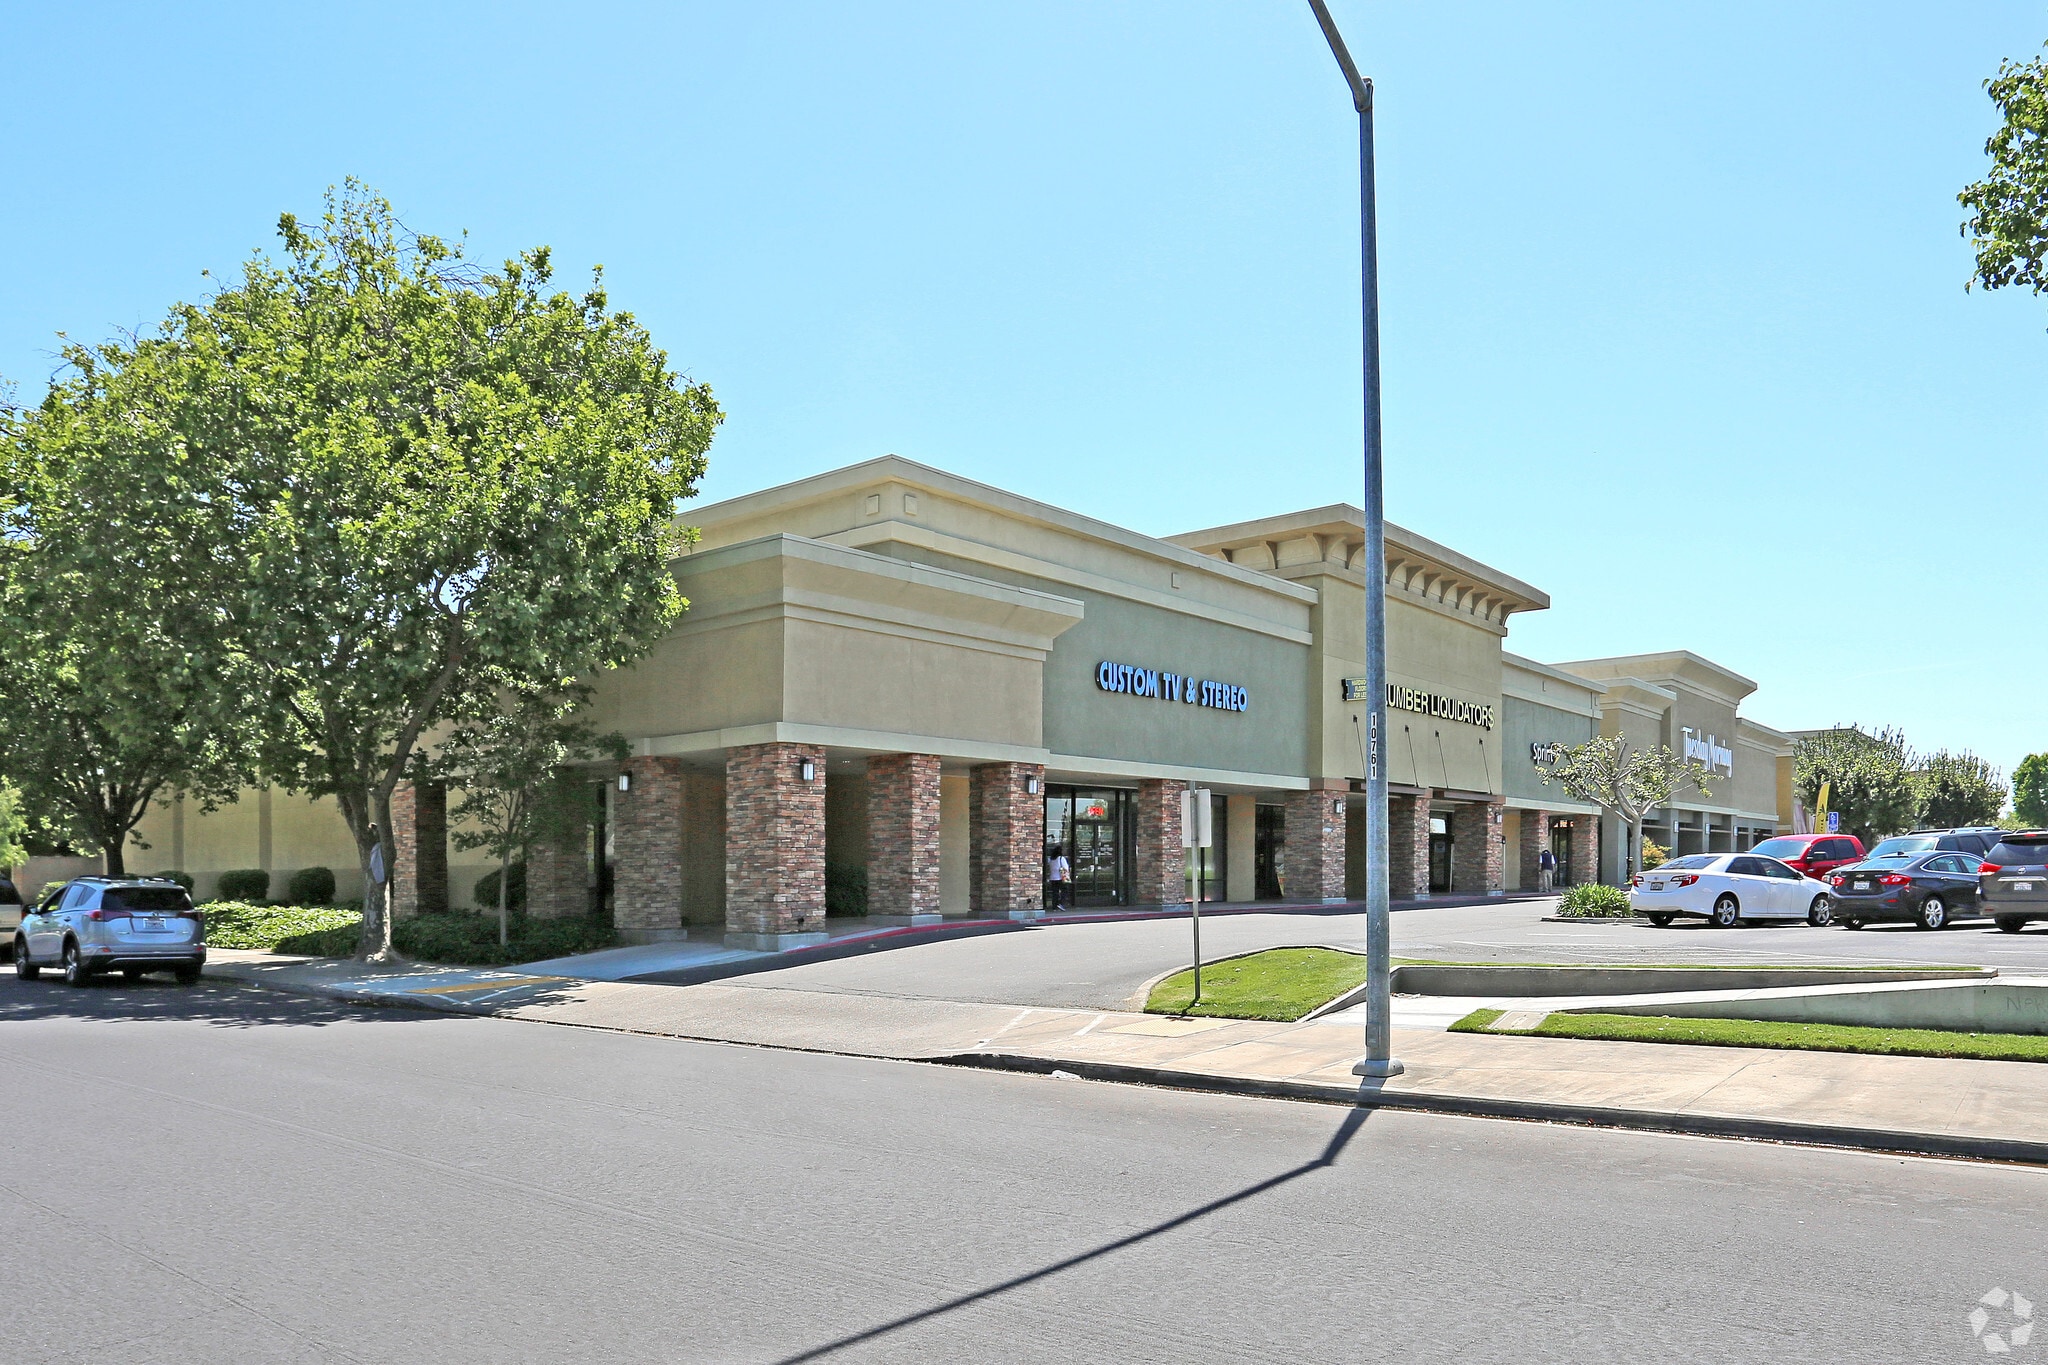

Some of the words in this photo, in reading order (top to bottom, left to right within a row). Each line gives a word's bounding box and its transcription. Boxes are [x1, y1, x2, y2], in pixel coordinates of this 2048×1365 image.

[1097, 661, 1158, 698] CUSTOM
[1161, 672, 1181, 701] TV
[1184, 676, 1196, 704] &
[1200, 680, 1249, 713] STEREO
[1384, 683, 1429, 714] UMBER
[1430, 693, 1495, 729] LIQUIDATORS
[1370, 714, 1378, 779] 10761
